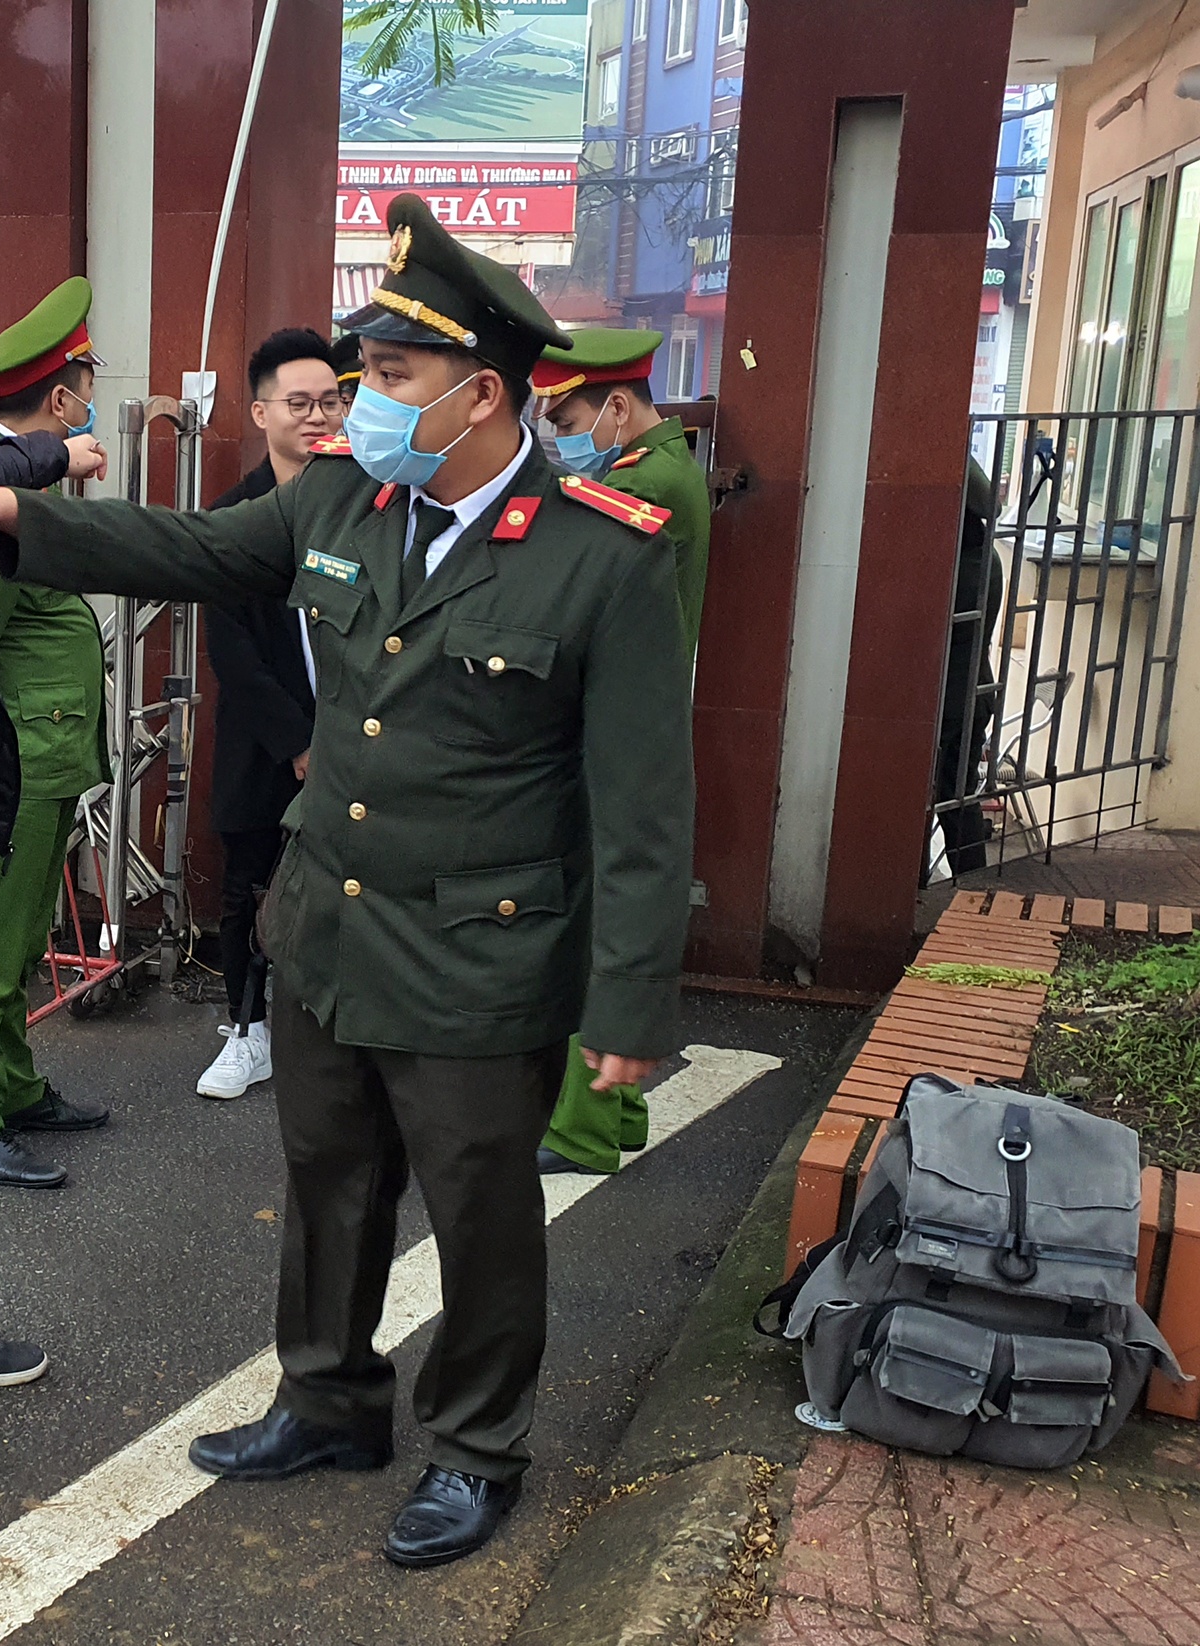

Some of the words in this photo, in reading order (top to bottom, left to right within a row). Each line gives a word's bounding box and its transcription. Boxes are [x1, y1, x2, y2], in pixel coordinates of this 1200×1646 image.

[340, 166, 380, 184] TNHH
[382, 164, 411, 184] XÂY
[461, 165, 479, 184] VÀ
